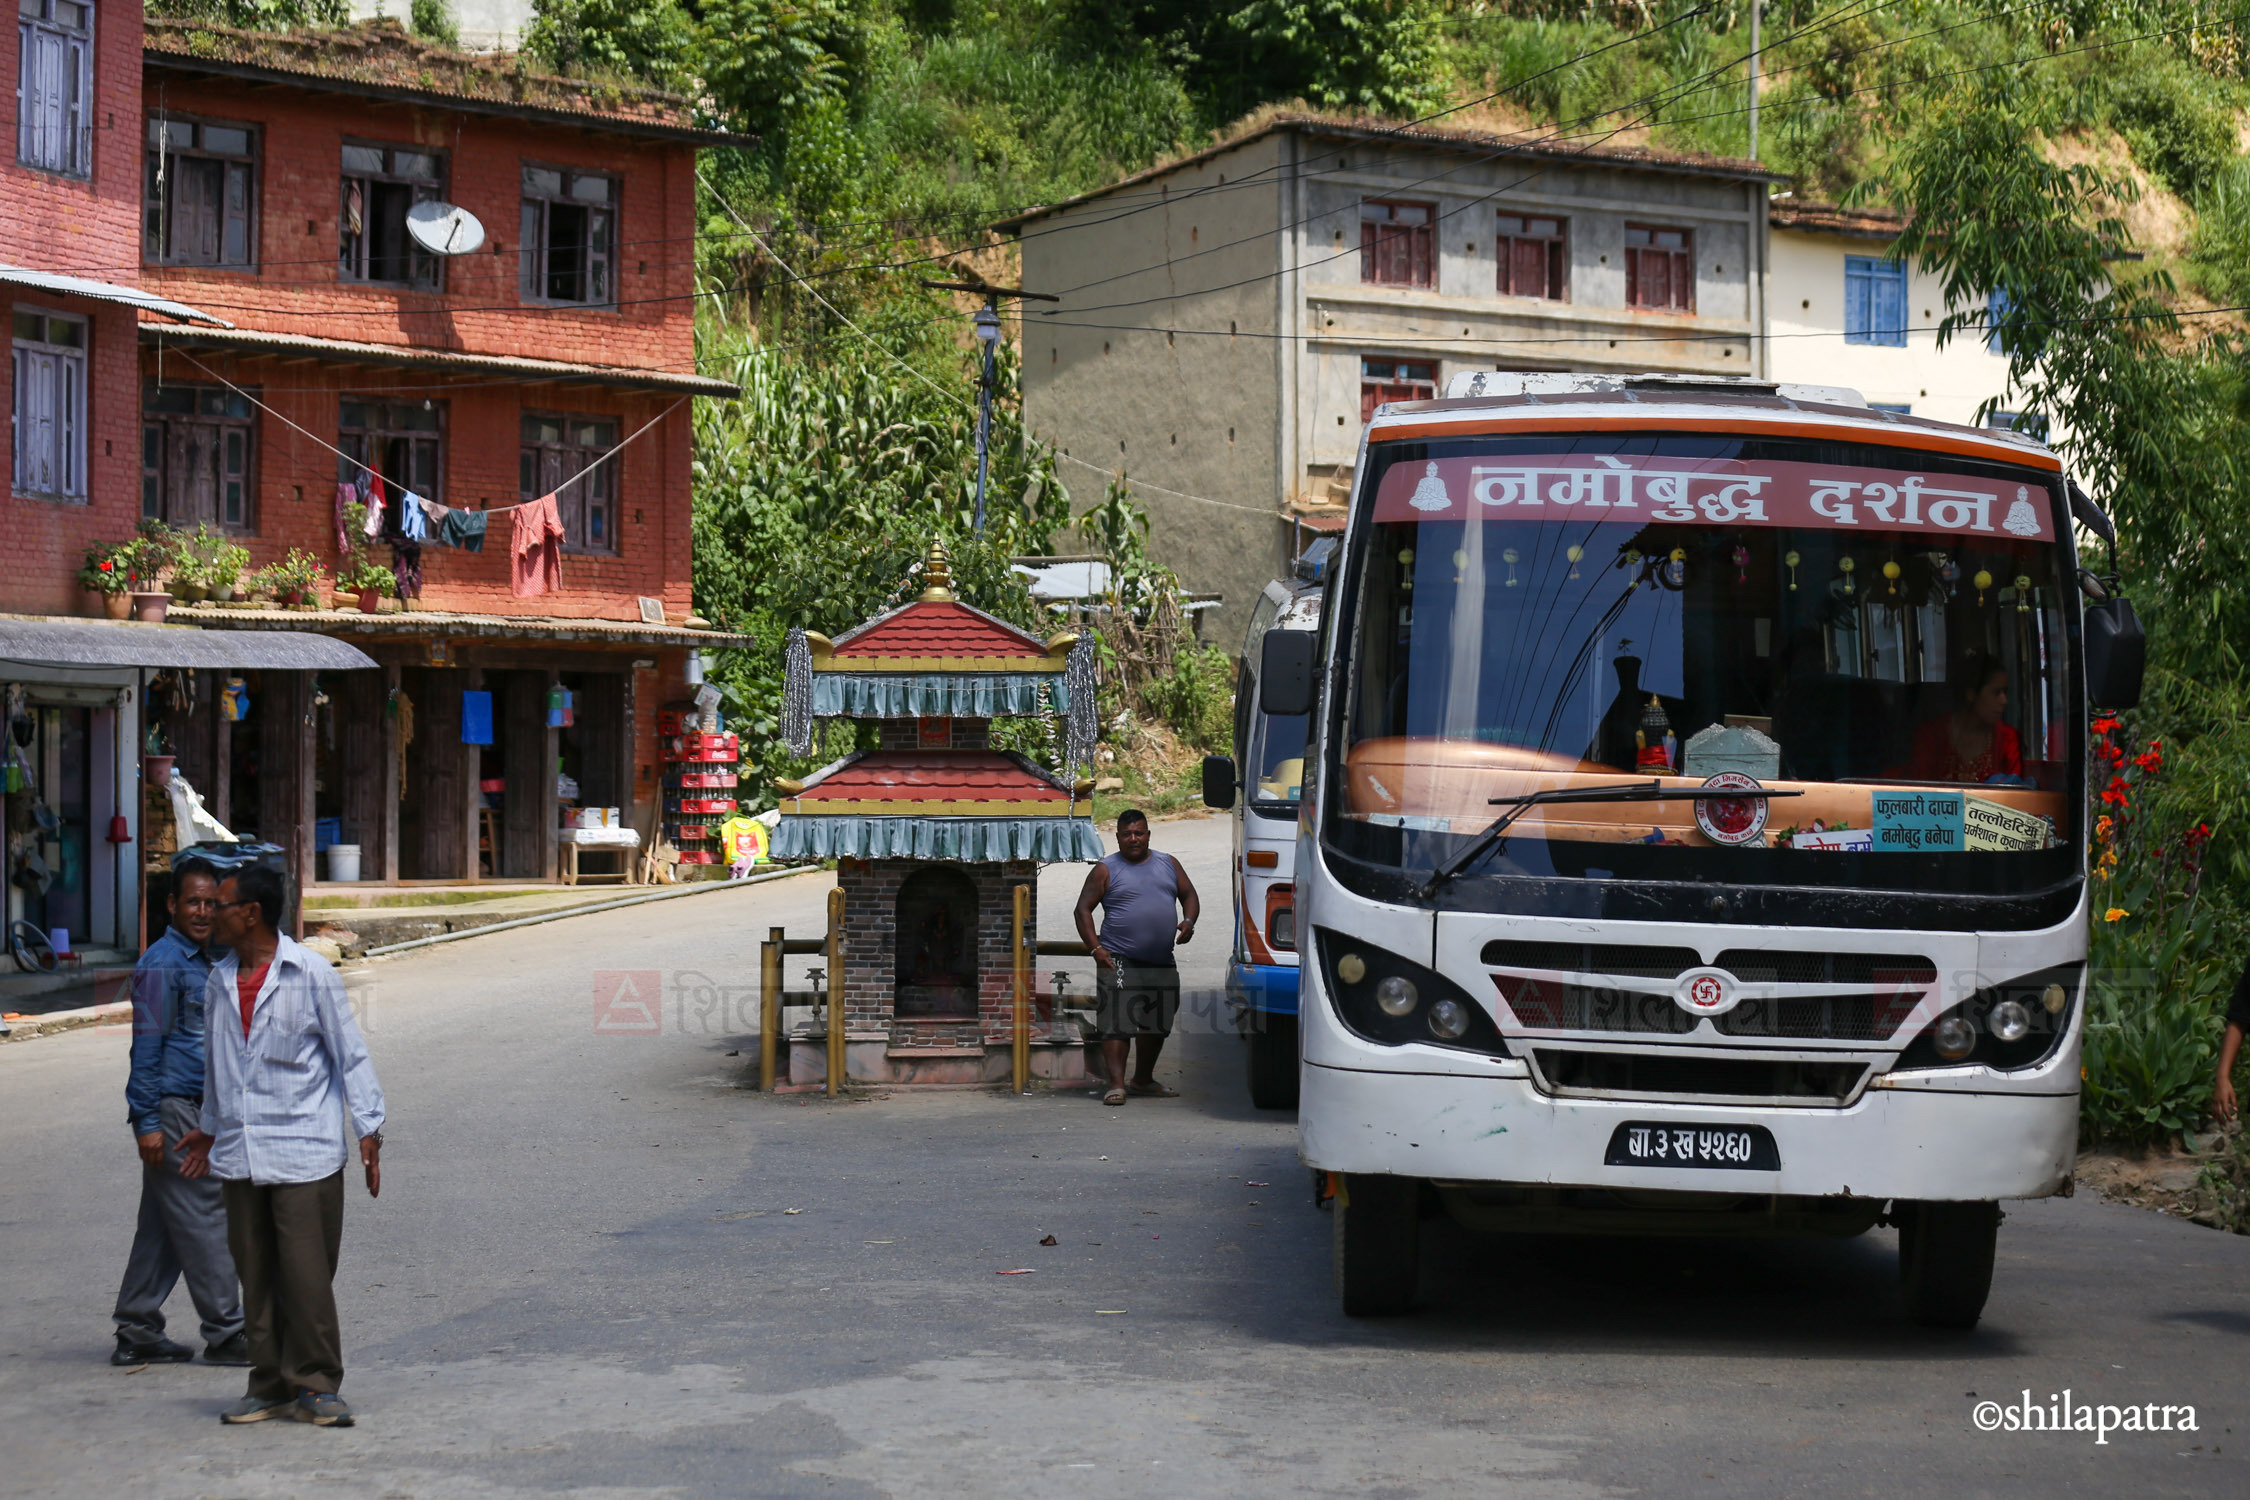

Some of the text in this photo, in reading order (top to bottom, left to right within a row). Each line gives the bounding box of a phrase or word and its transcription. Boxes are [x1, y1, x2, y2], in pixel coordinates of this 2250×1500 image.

[1473, 456, 1998, 532] नमोबुद्ध दर्शन
[1877, 795, 1925, 819] फुलबारी
[1924, 824, 1955, 845] बनेपा
[1673, 1130, 1696, 1159] ख
[1699, 1130, 1751, 1162] ५२६०
